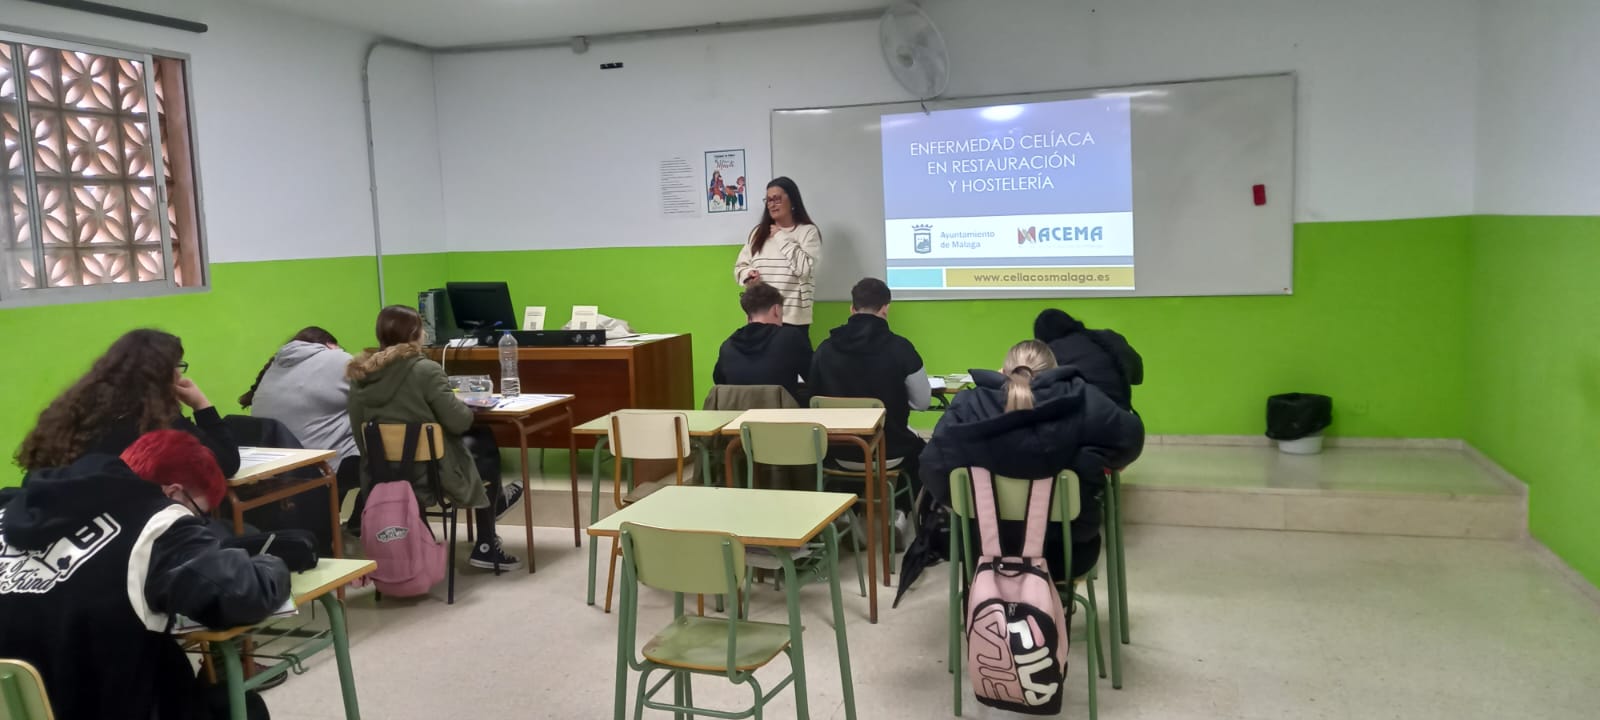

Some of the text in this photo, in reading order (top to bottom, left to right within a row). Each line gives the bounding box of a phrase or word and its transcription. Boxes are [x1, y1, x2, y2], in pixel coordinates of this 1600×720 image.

[911, 130, 1095, 156] ENFERMEDAD CELÍACA
[928, 151, 1076, 175] EN RESTAURACIÓN
[948, 172, 1054, 193] Y HOSTELERÍA
[940, 231, 996, 239] Ayuntamiento
[940, 241, 950, 249] de
[973, 610, 1024, 703] FILA
[1007, 615, 1059, 706] FILA
